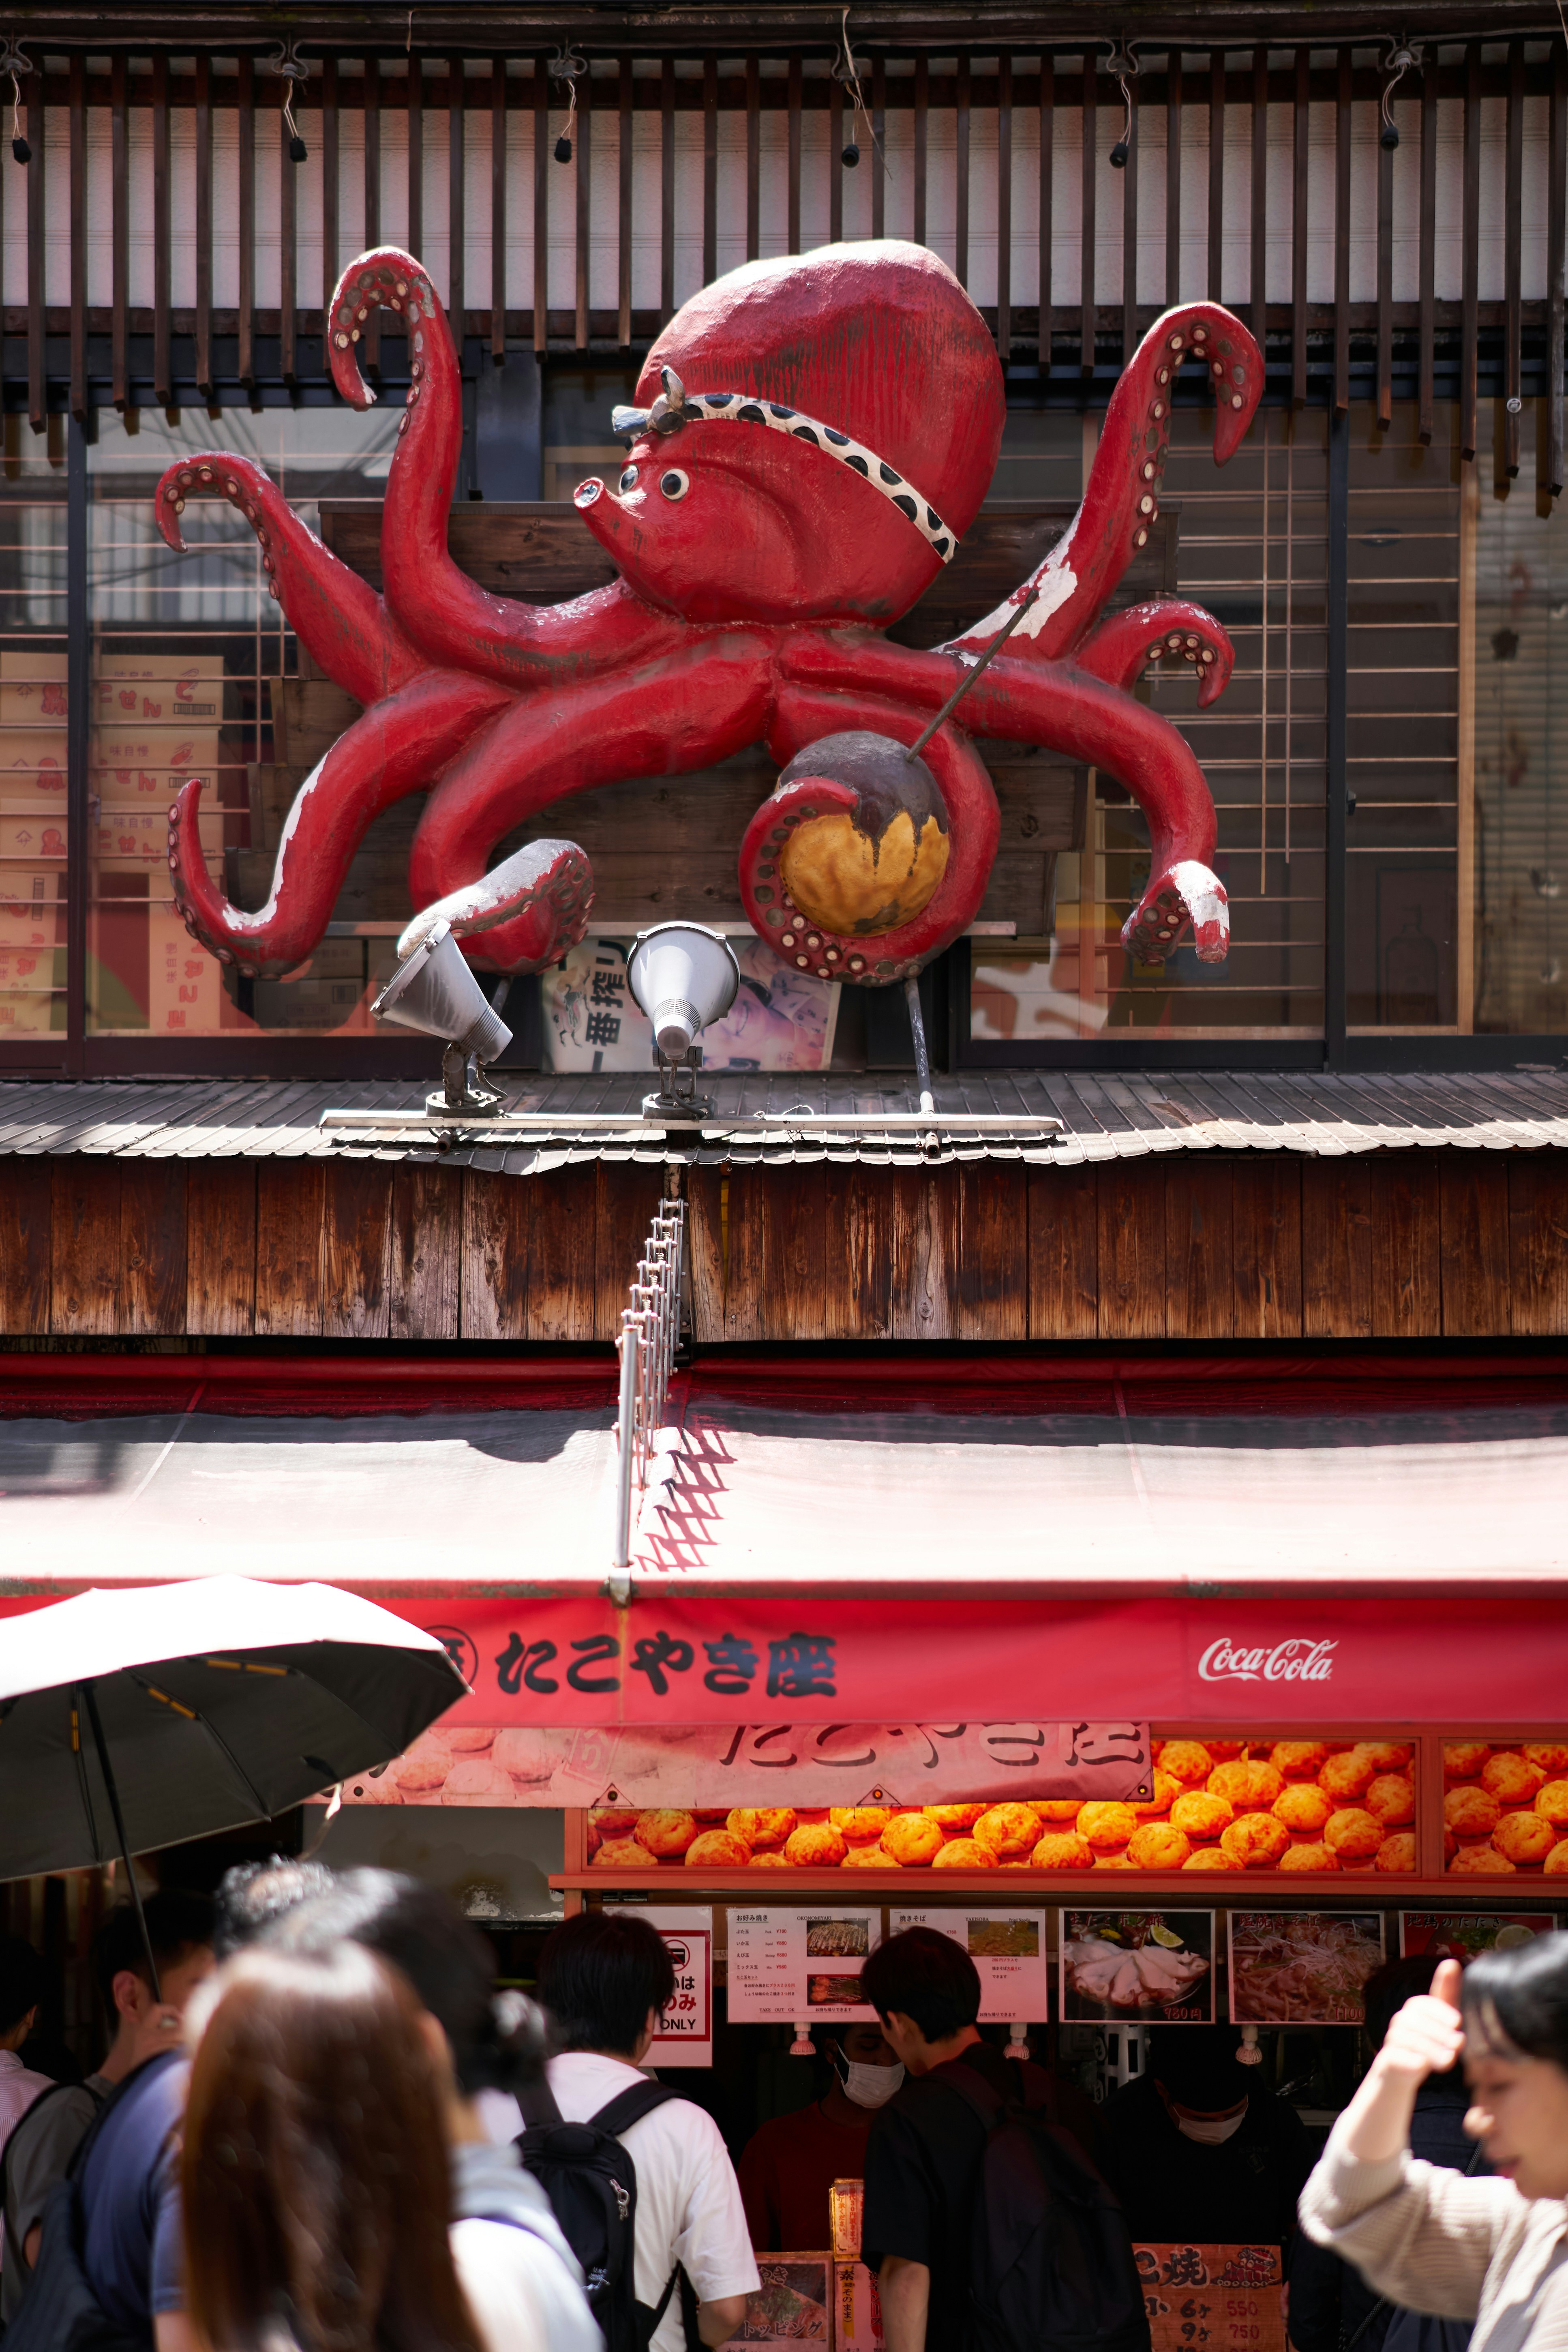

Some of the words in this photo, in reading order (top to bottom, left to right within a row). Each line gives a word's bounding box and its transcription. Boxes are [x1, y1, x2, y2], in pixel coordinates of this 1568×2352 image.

[110, 746, 149, 757] 味自慢
[114, 817, 154, 829] 味自慢
[585, 939, 628, 1072] 一番搾り
[495, 1631, 836, 1698] たこやき座
[1198, 1637, 1339, 1681] Coca-Cola
[1239, 1913, 1320, 1927] 塩焼きそば
[1407, 1913, 1501, 1929] 地鶏のたたき
[1335, 2007, 1365, 2020] 1100
[660, 2018, 696, 2030] ONLY
[1226, 2300, 1258, 2317] 550
[744, 2320, 823, 2337] トッピング
[1229, 2323, 1260, 2340] 750
